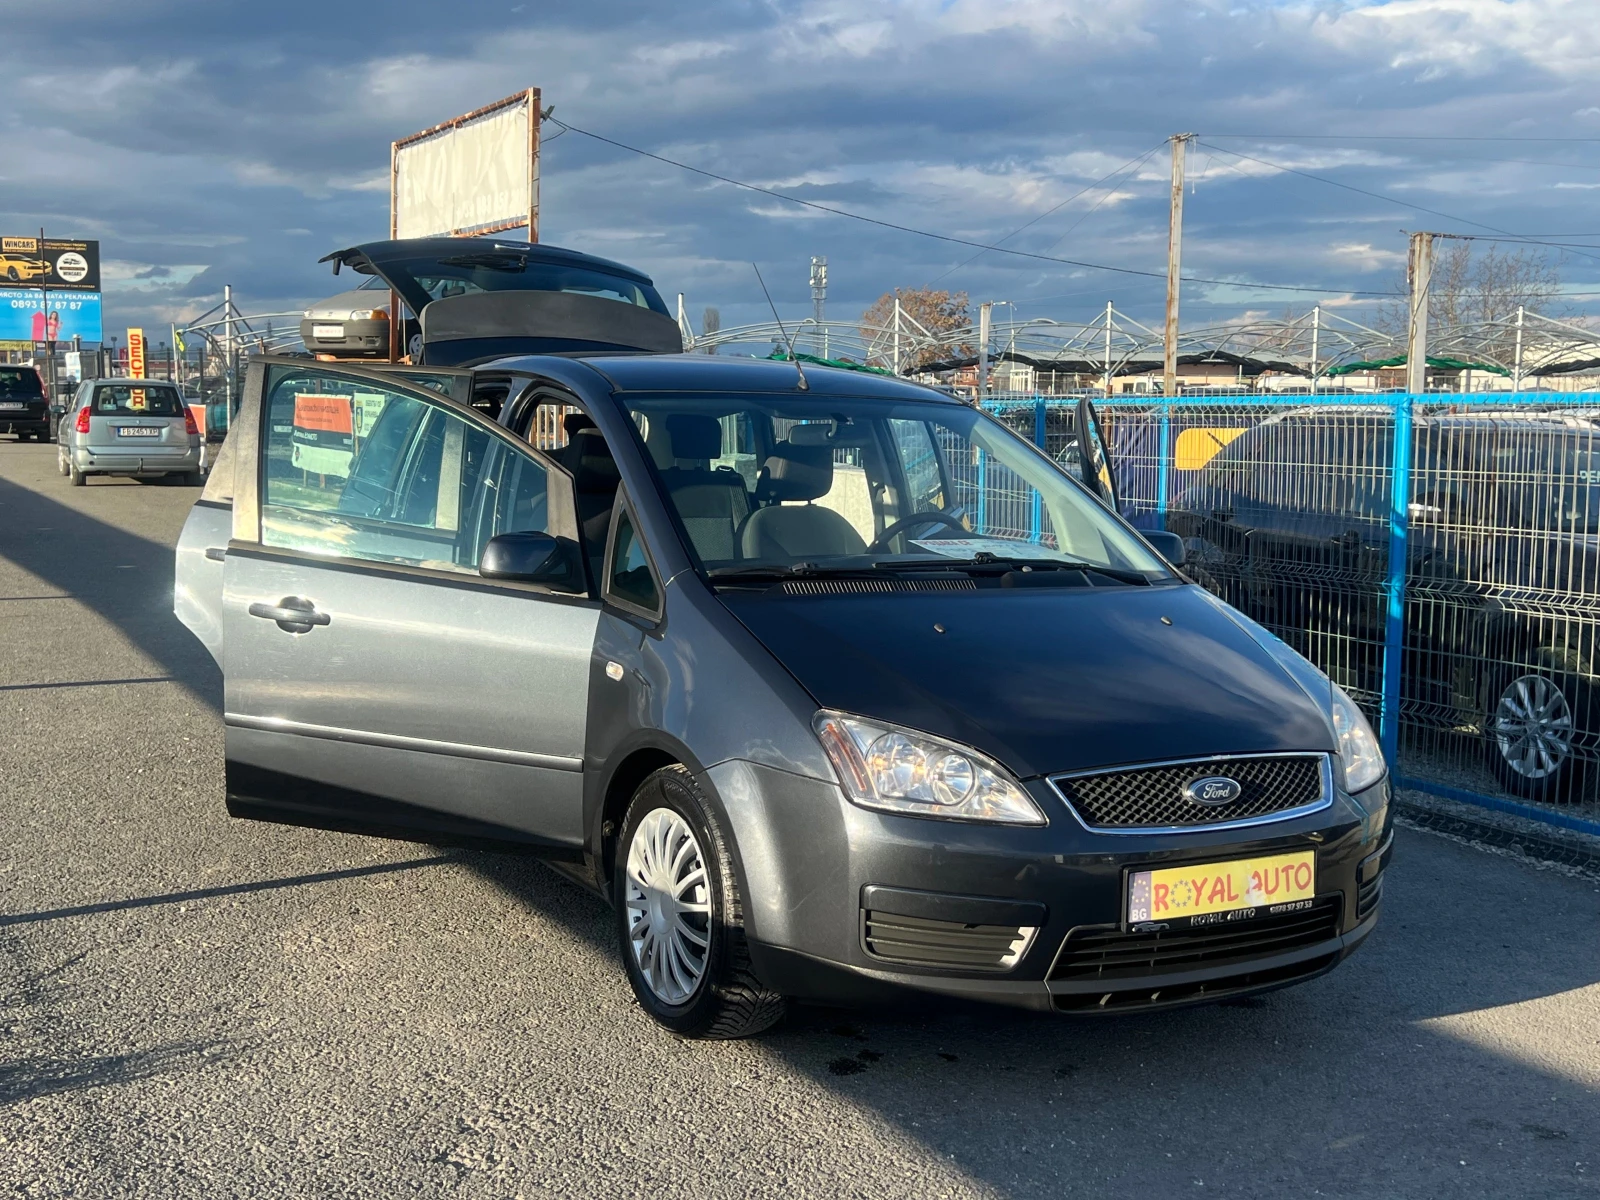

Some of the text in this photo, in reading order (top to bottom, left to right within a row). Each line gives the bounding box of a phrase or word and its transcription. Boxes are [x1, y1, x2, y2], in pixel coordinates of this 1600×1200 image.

[4, 240, 35, 249] WINCARS
[11, 299, 82, 310] 0893 87 87 87
[1203, 783, 1230, 798] Ford
[1154, 862, 1312, 912] ROYAL AUTO
[1131, 908, 1147, 921] BG
[1190, 913, 1225, 926] ROYAL
[1227, 908, 1256, 921] AUTO
